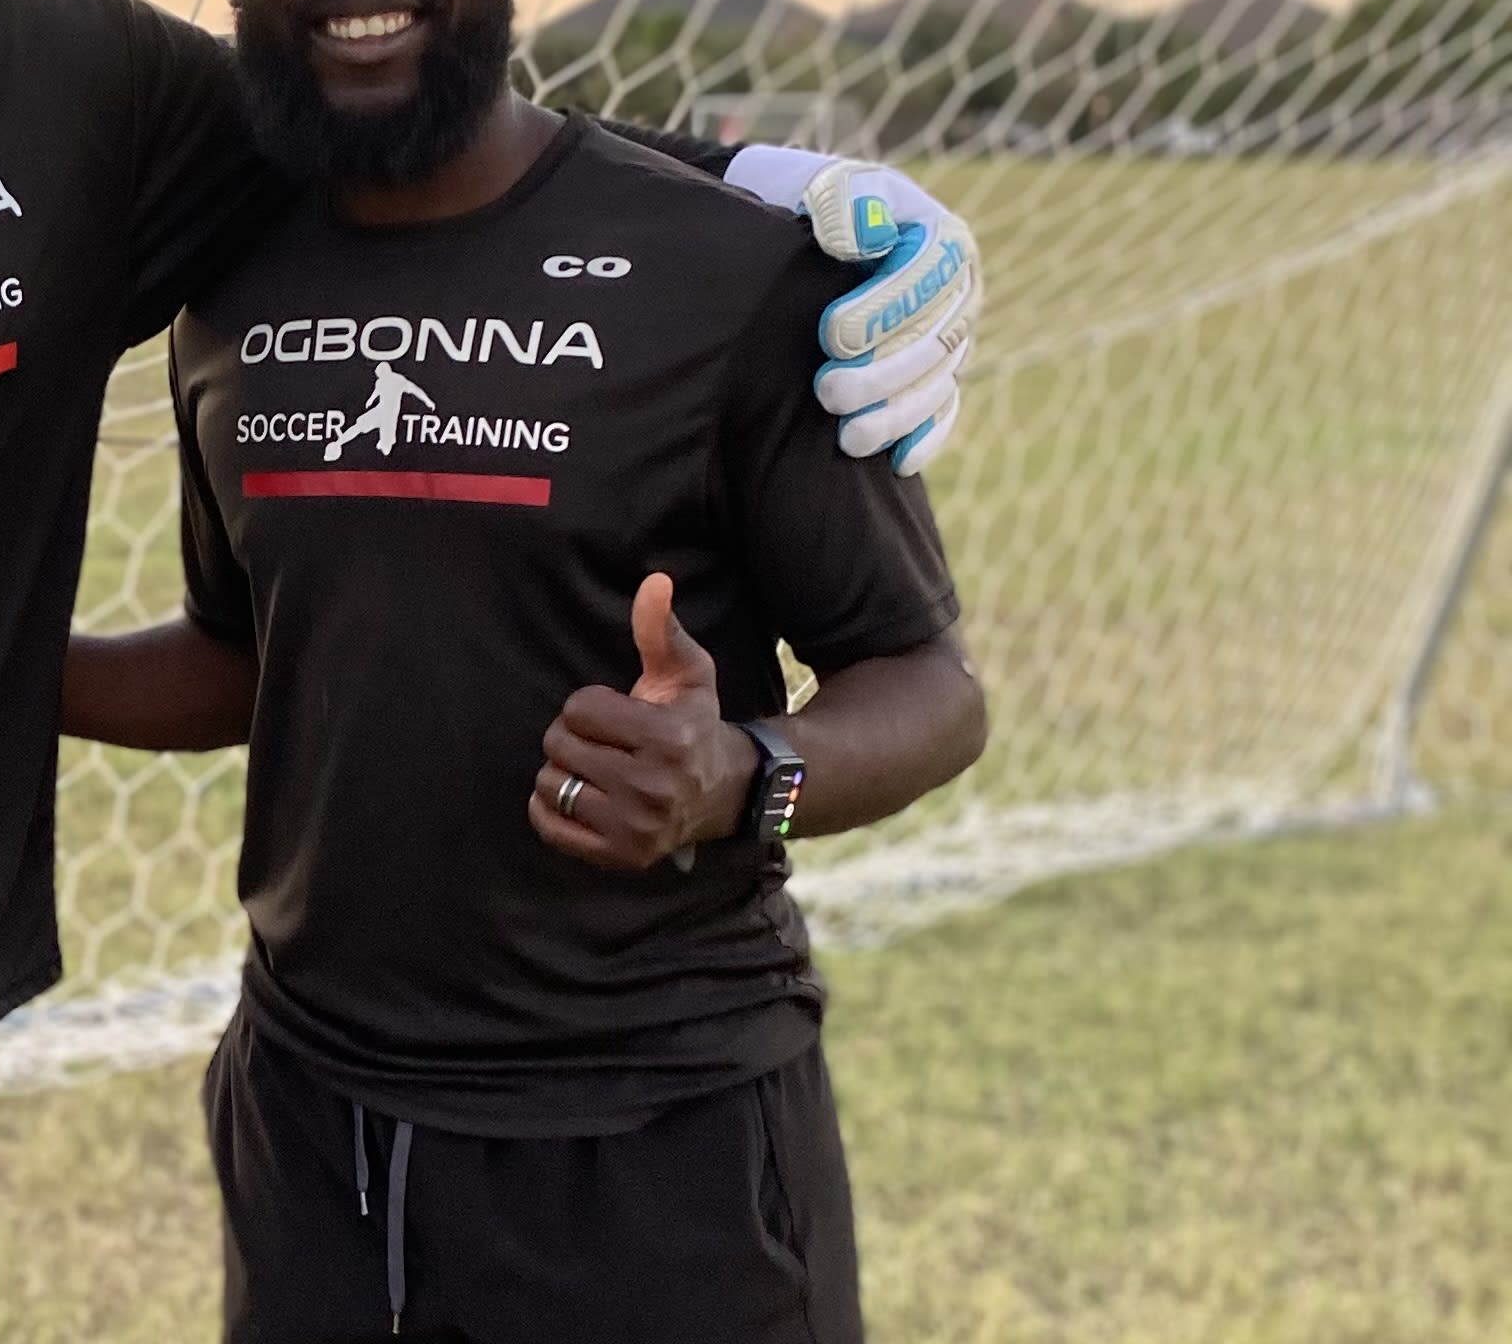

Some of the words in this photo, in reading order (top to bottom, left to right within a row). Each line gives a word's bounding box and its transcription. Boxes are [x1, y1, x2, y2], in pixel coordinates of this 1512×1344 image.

[542, 254, 632, 279] CO
[865, 239, 965, 344] reusch
[240, 316, 604, 370] OGBONNA
[236, 410, 346, 443] SOCCER
[402, 414, 570, 454] TRAINING
